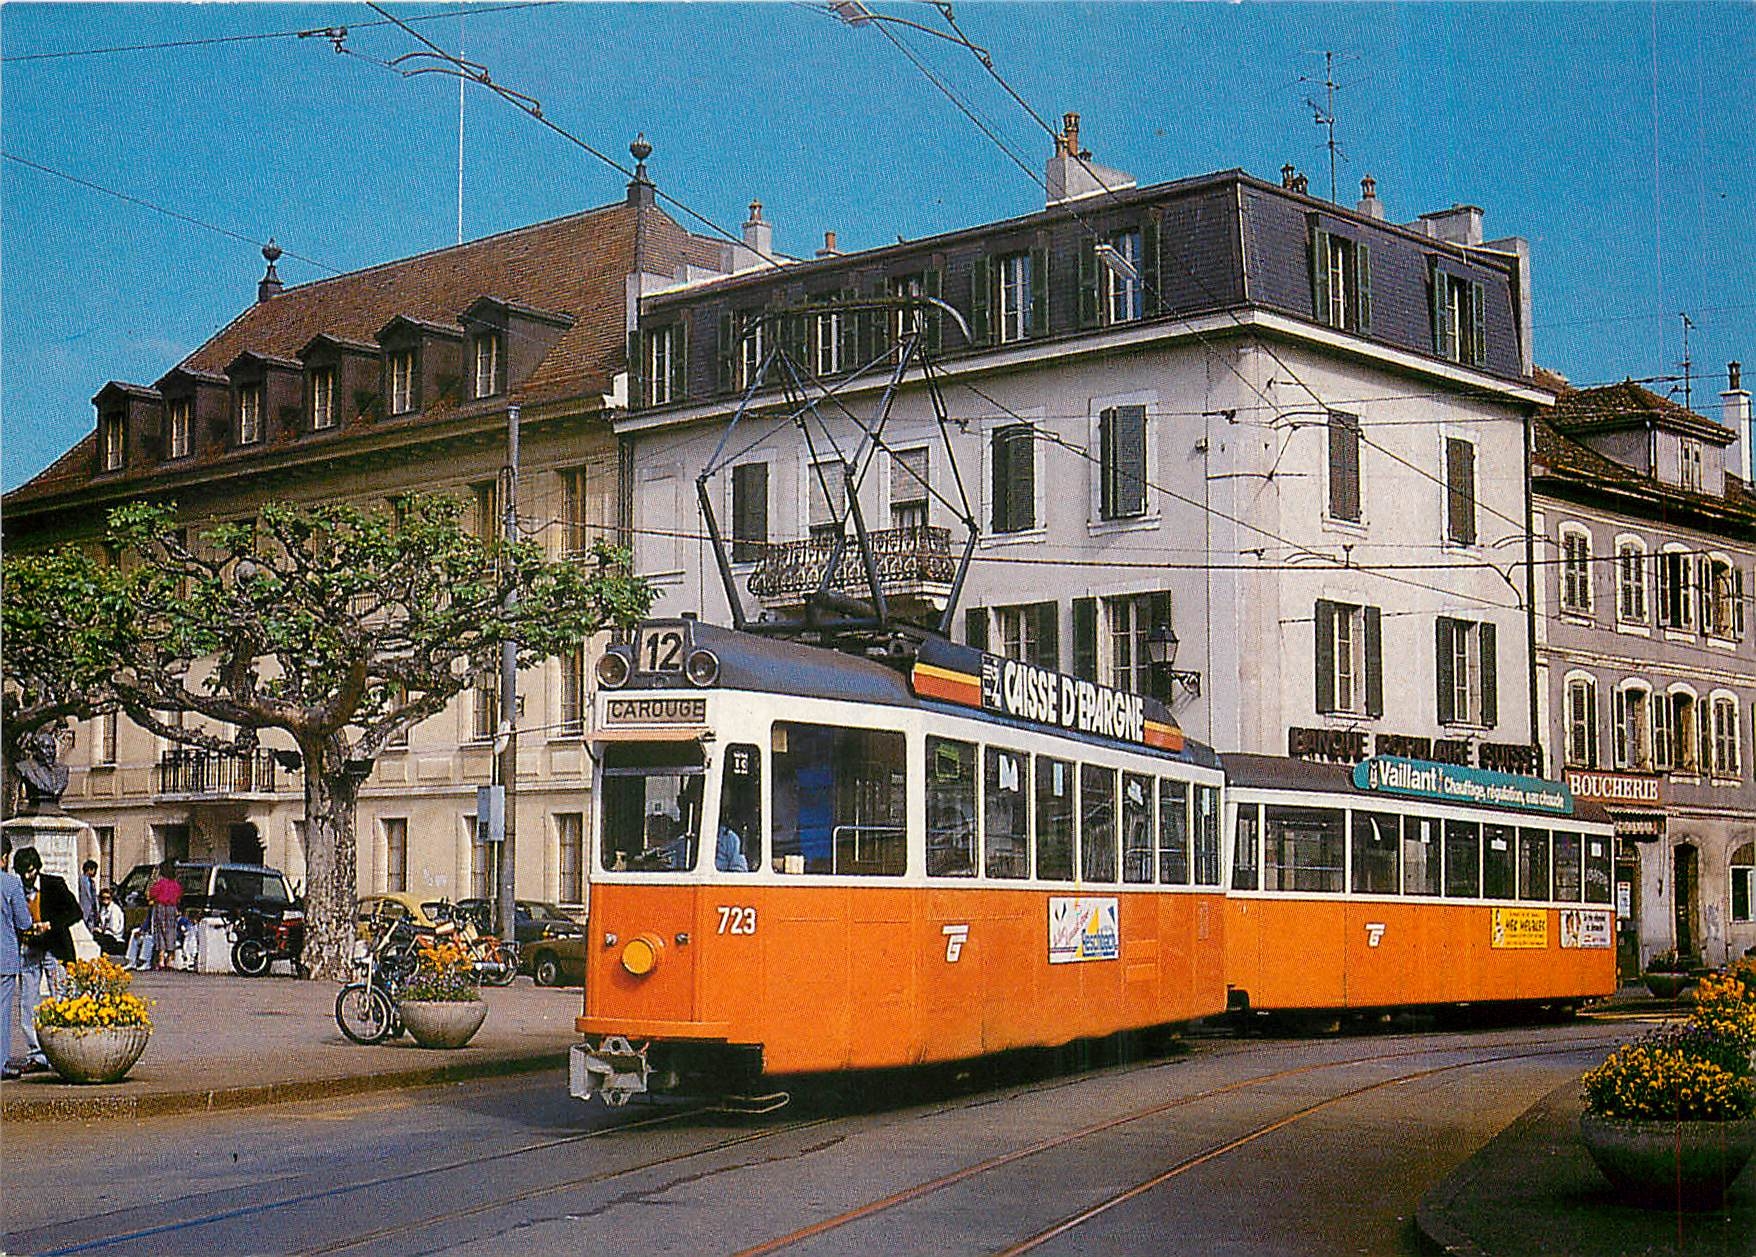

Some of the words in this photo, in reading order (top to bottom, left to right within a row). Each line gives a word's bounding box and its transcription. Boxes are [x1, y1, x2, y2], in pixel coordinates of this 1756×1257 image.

[646, 632, 682, 672] 12
[610, 700, 706, 719] CAROUGE
[1004, 660, 1058, 724] CAISSE
[1061, 676, 1144, 743] D'EPARGNE
[1289, 726, 1369, 765] BANQUE
[1379, 760, 1437, 792] Vaillant
[1568, 773, 1659, 800] BOUCHERIE
[716, 906, 757, 935] 723
